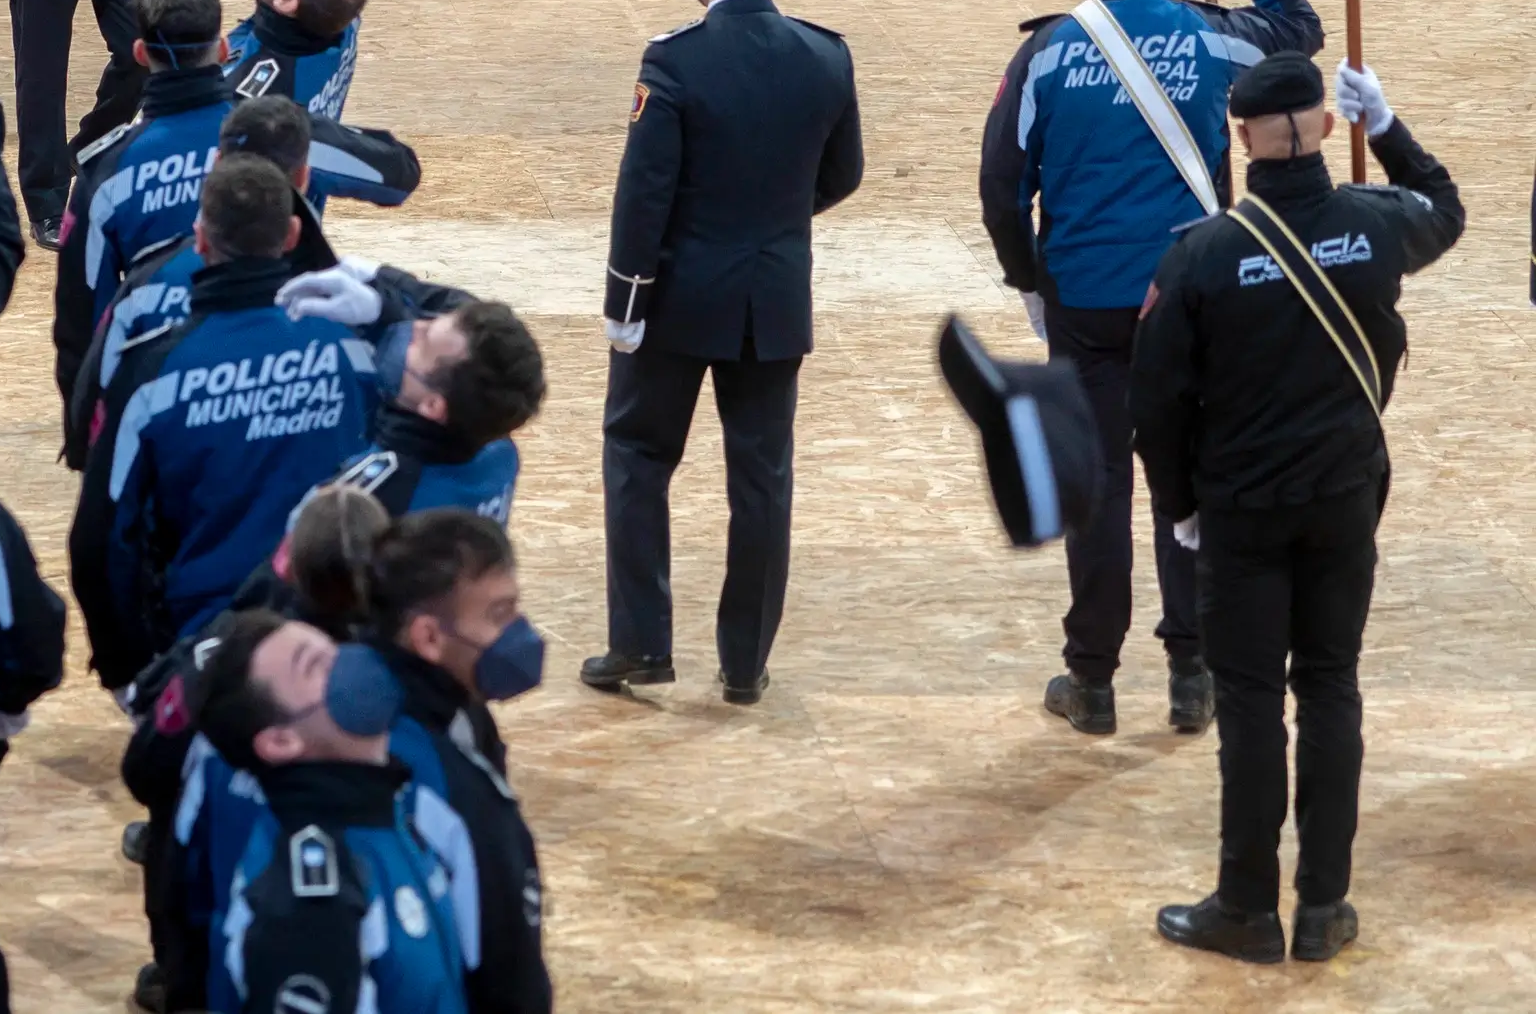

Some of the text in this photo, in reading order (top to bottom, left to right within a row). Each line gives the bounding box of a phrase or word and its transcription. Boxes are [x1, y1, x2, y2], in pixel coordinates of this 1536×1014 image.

[179, 339, 338, 402] POLICÍA
[185, 375, 345, 428] MUNICIPAL
[245, 401, 344, 442] Madrid
